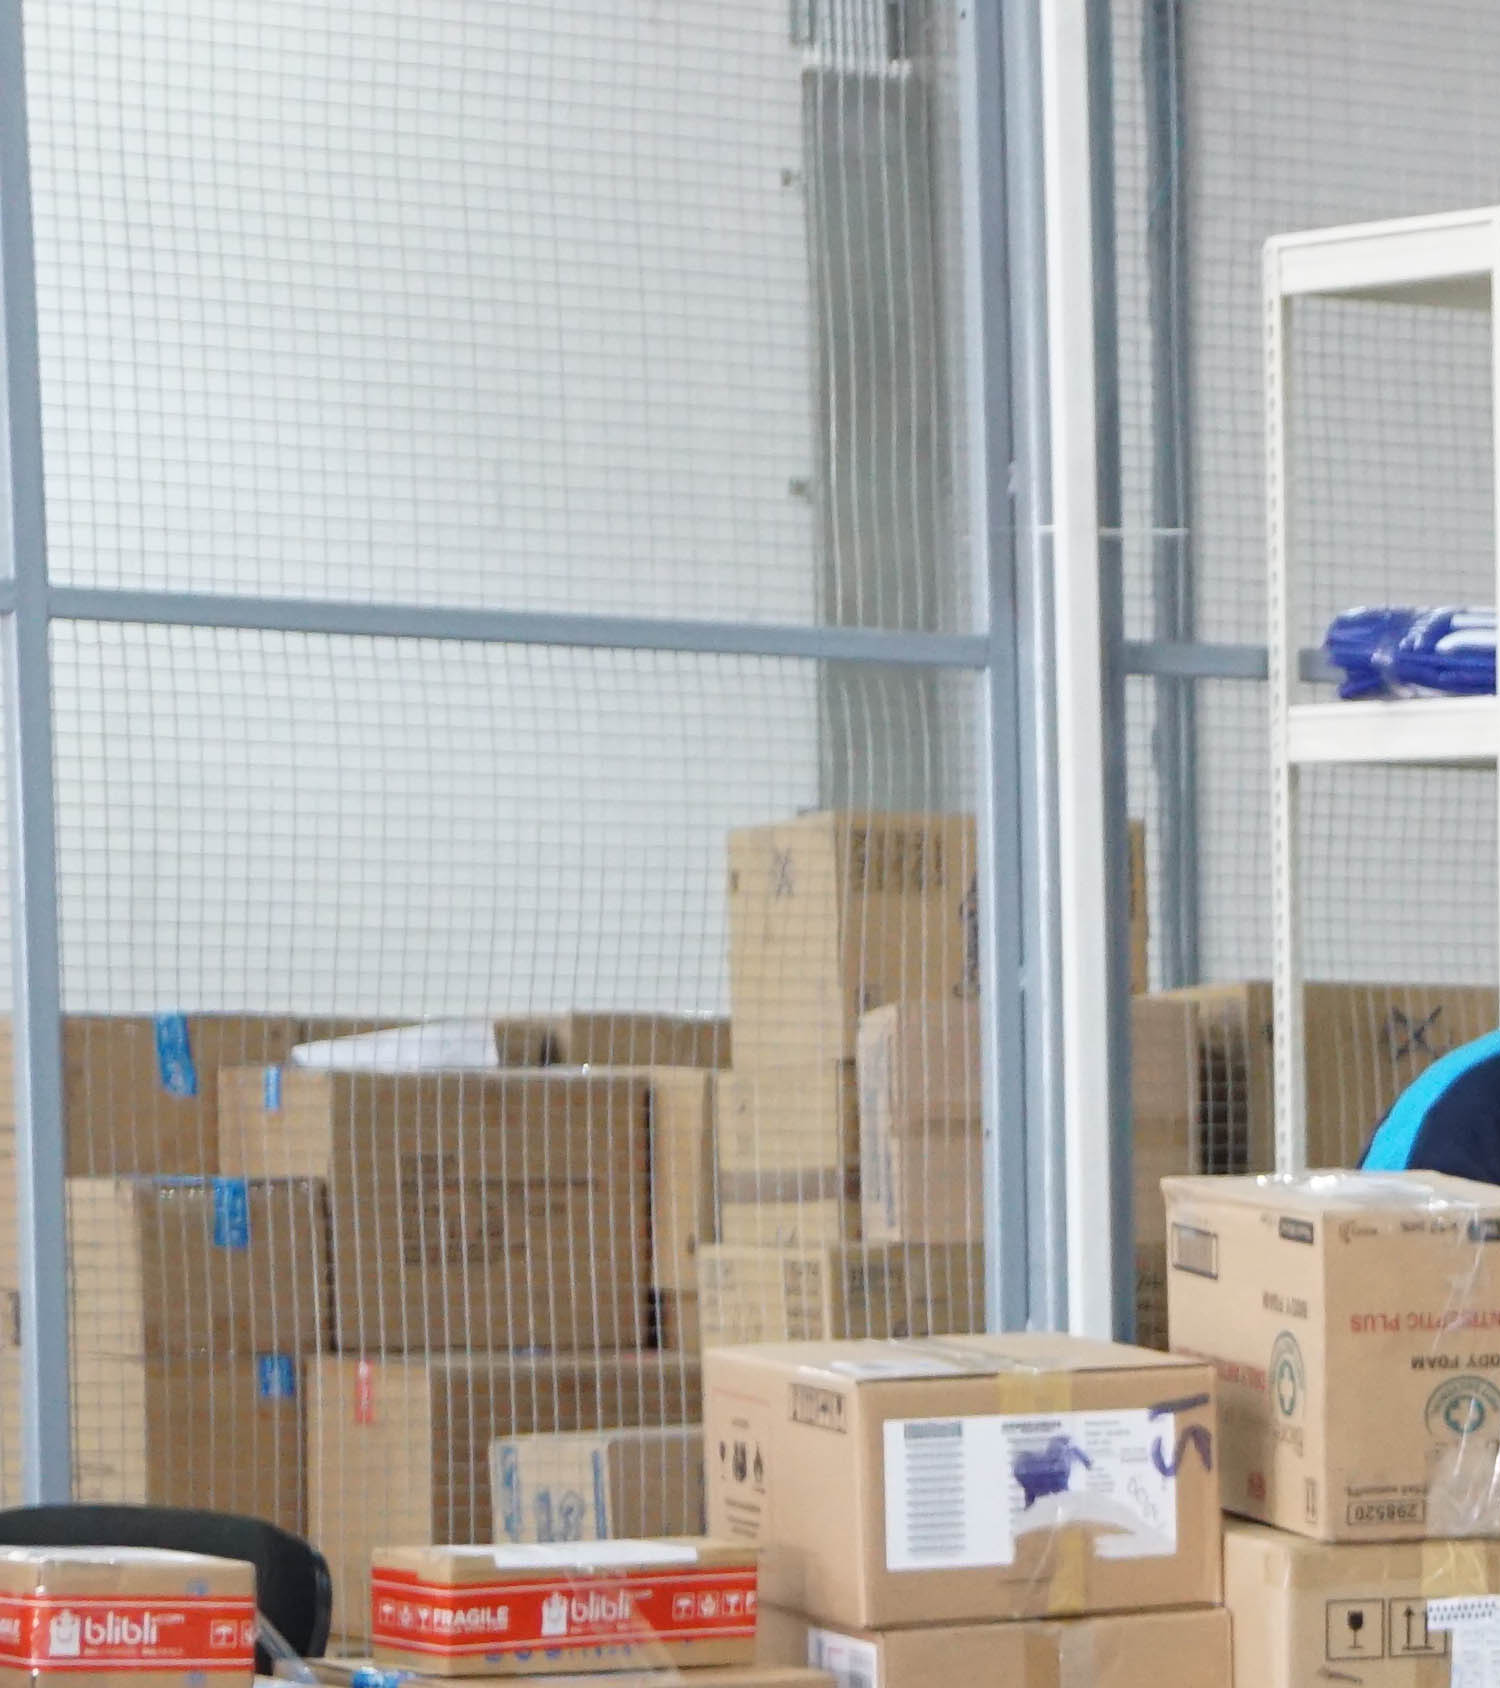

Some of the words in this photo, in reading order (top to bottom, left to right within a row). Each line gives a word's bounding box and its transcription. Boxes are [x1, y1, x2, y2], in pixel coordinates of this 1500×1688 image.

[1349, 1312, 1401, 1335] PLUS
[1411, 1355, 1460, 1371] FOAM
[432, 1605, 510, 1628] FRAGILE
